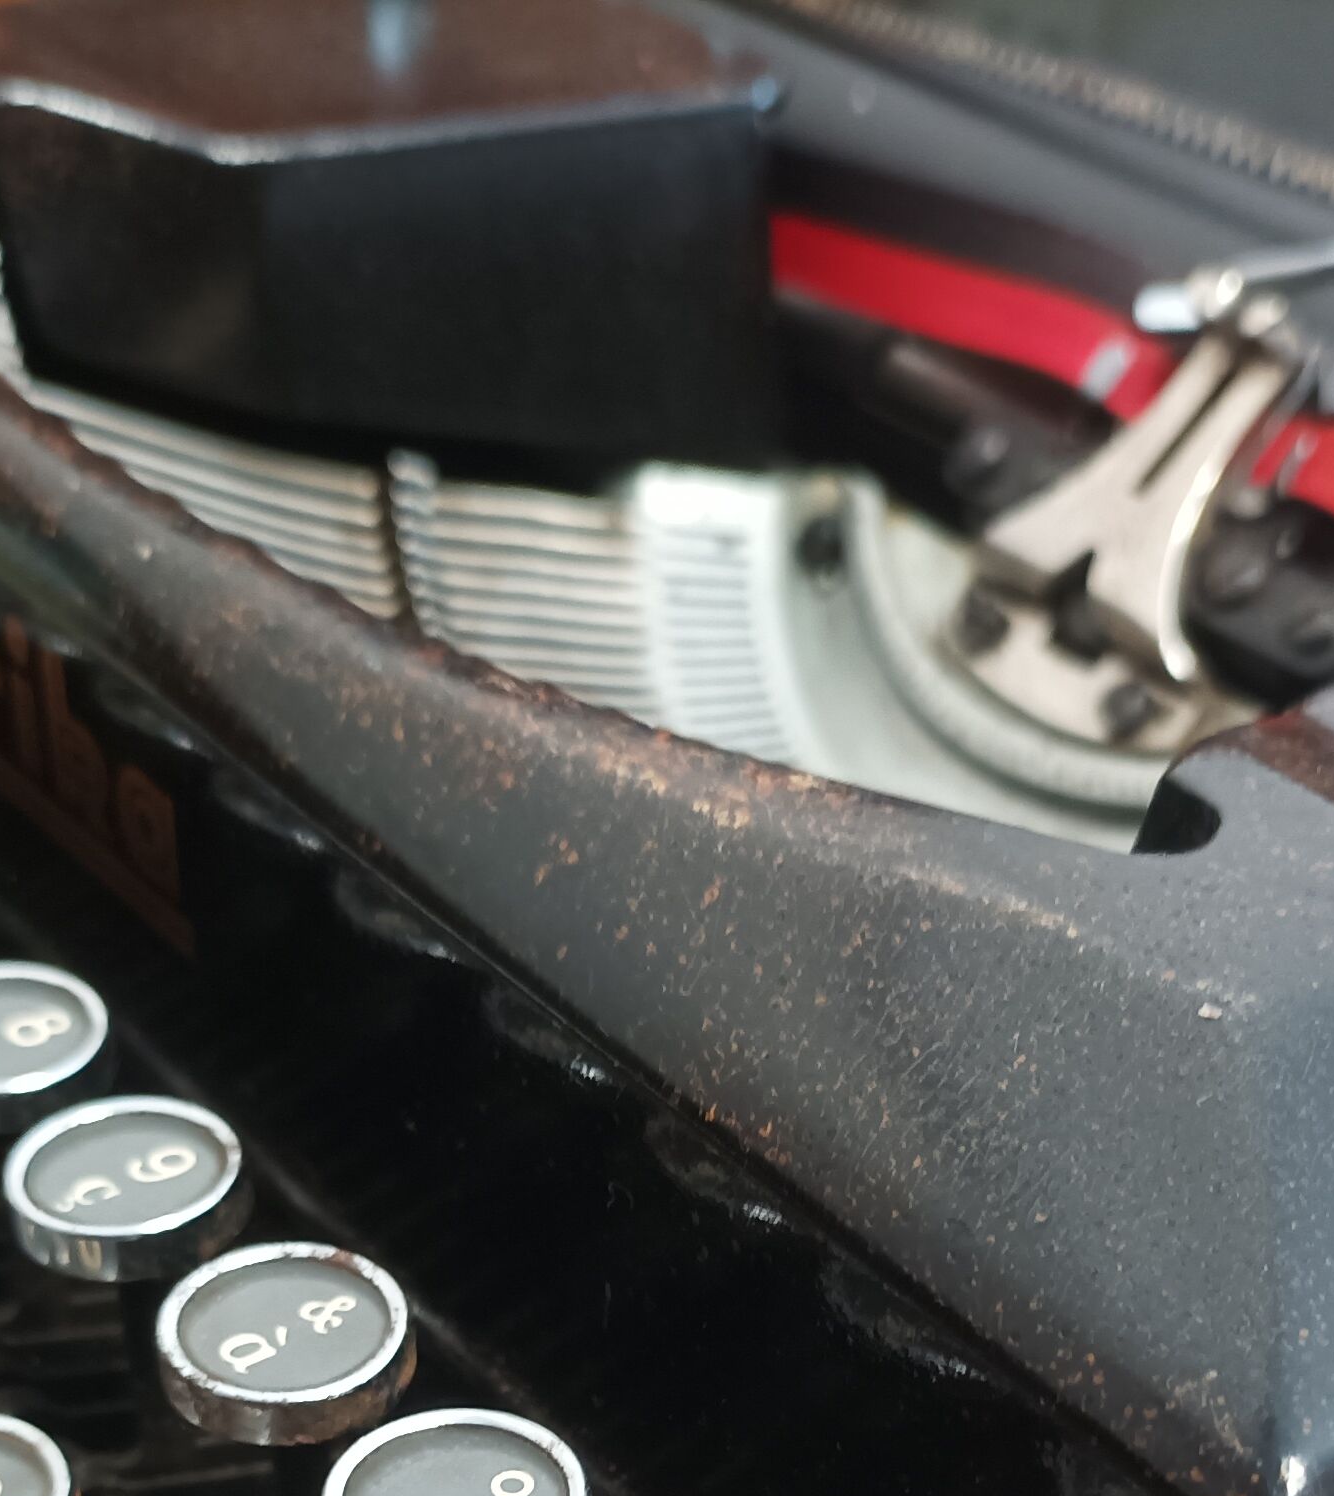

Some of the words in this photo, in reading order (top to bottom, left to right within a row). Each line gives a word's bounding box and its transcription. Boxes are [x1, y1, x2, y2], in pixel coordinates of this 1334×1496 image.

[0, 1009, 72, 1048] 8
[126, 1143, 197, 1184] 9
[299, 1294, 357, 1335] &
